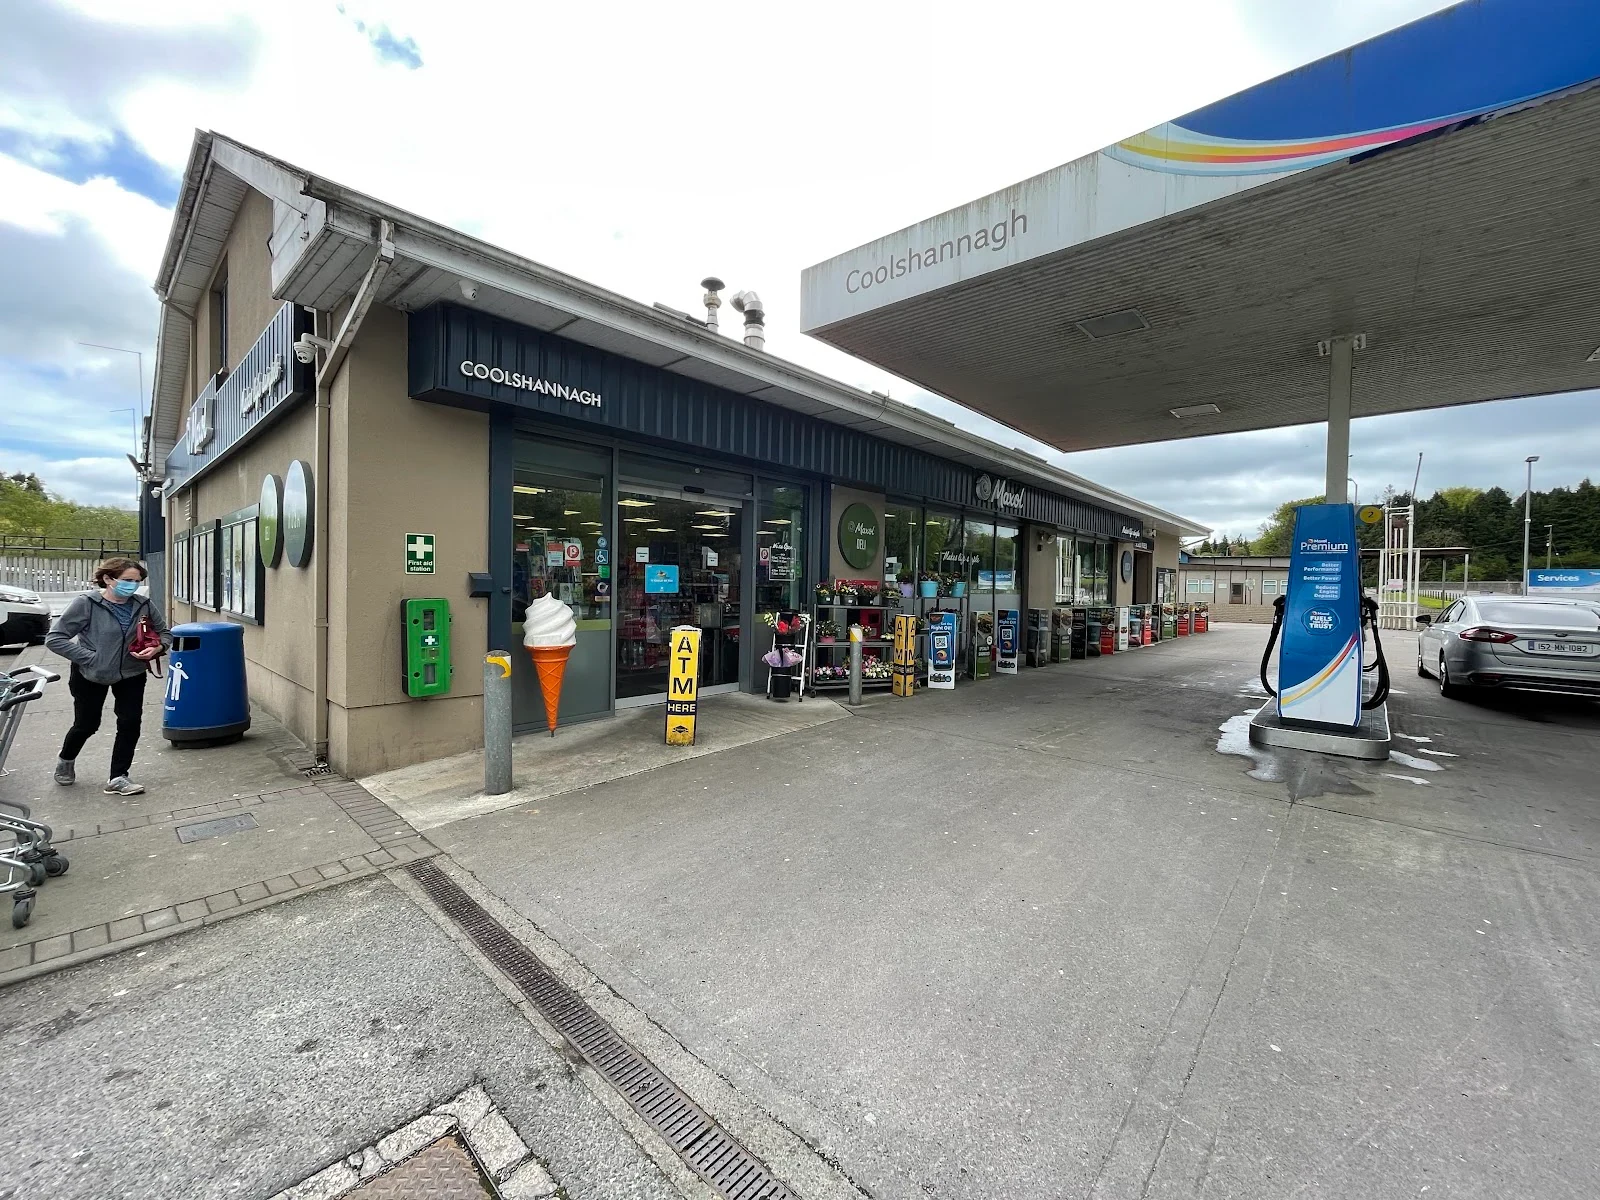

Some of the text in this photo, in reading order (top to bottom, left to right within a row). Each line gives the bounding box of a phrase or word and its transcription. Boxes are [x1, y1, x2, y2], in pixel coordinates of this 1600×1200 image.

[846, 209, 1028, 294] Coolshannagh
[460, 360, 601, 407] COOLSHANNAGH
[991, 479, 1025, 509] Maxol
[855, 522, 876, 536] Maxol
[1300, 541, 1349, 551] Premium
[1537, 574, 1580, 582] Services
[895, 620, 903, 661] ATM
[672, 636, 693, 695] ATM
[667, 703, 696, 713] HERE
